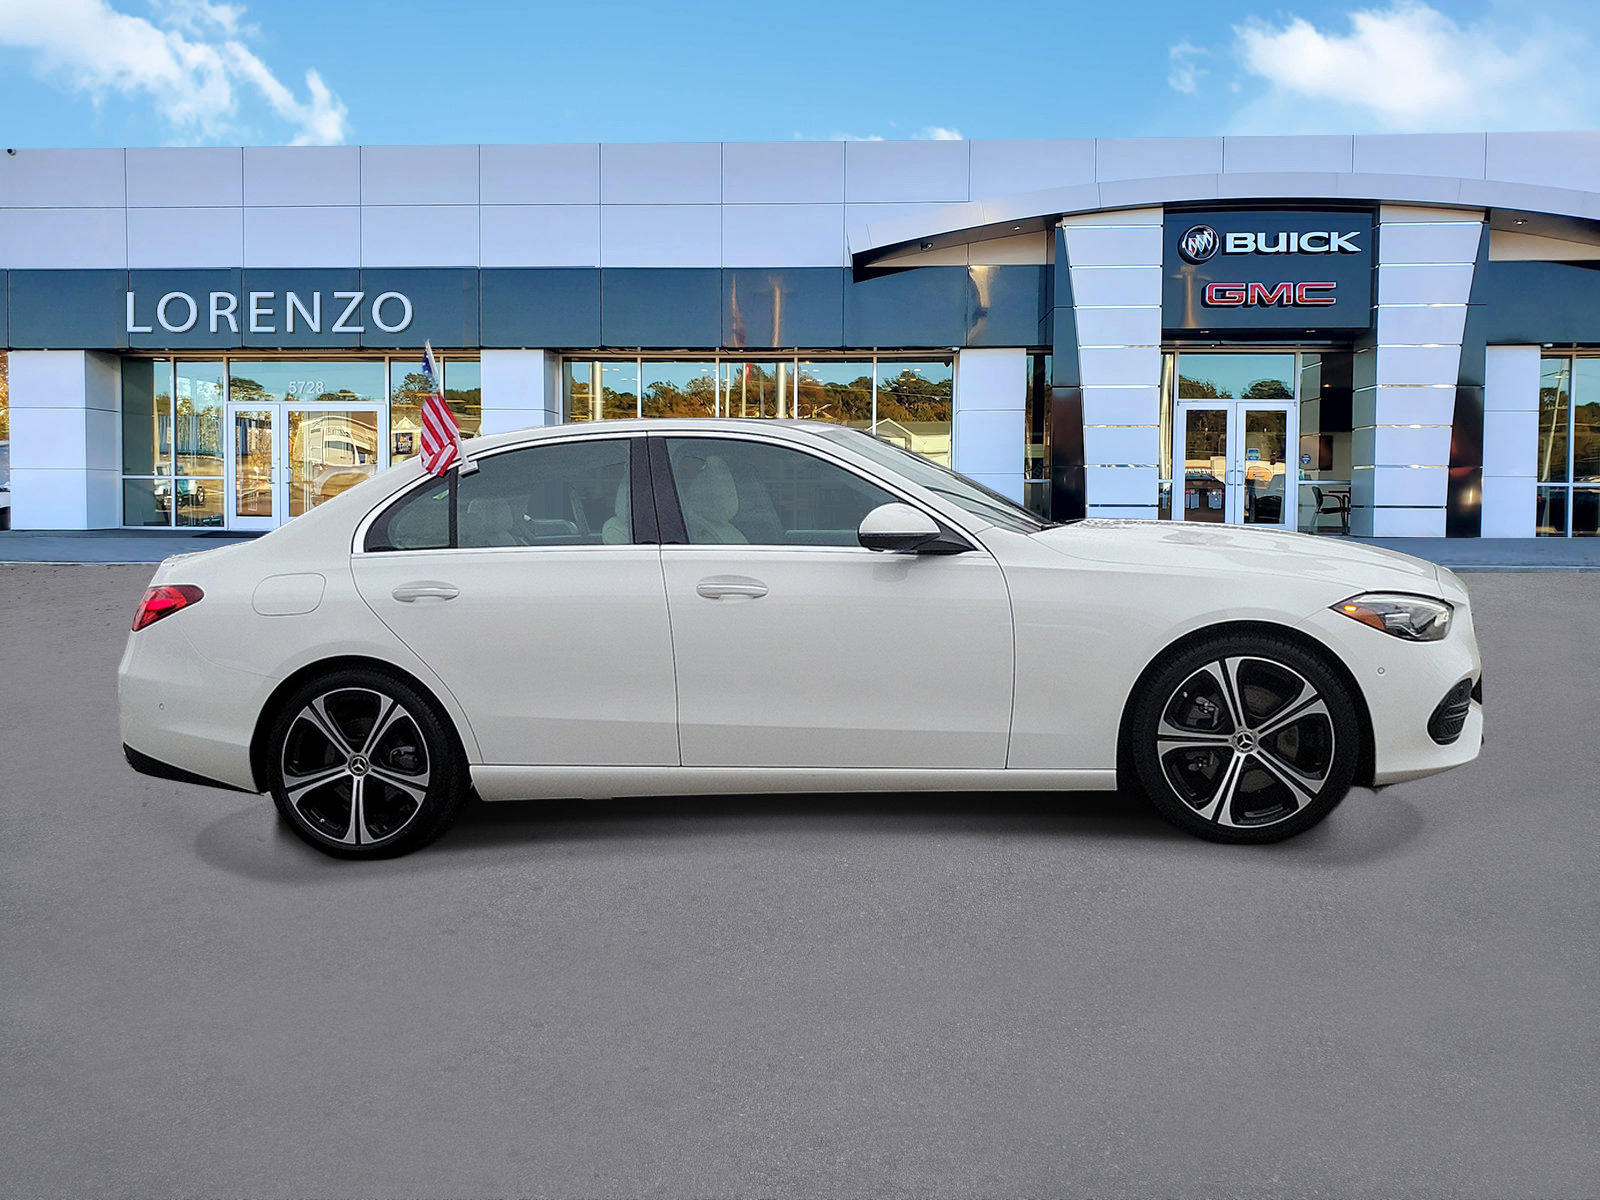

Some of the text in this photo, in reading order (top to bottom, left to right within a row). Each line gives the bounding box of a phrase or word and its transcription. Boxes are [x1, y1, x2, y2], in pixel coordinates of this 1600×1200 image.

[1225, 231, 1362, 254] BUICK
[1204, 282, 1337, 306] GMC
[126, 291, 414, 333] LORENZO
[288, 380, 325, 394] 5728
